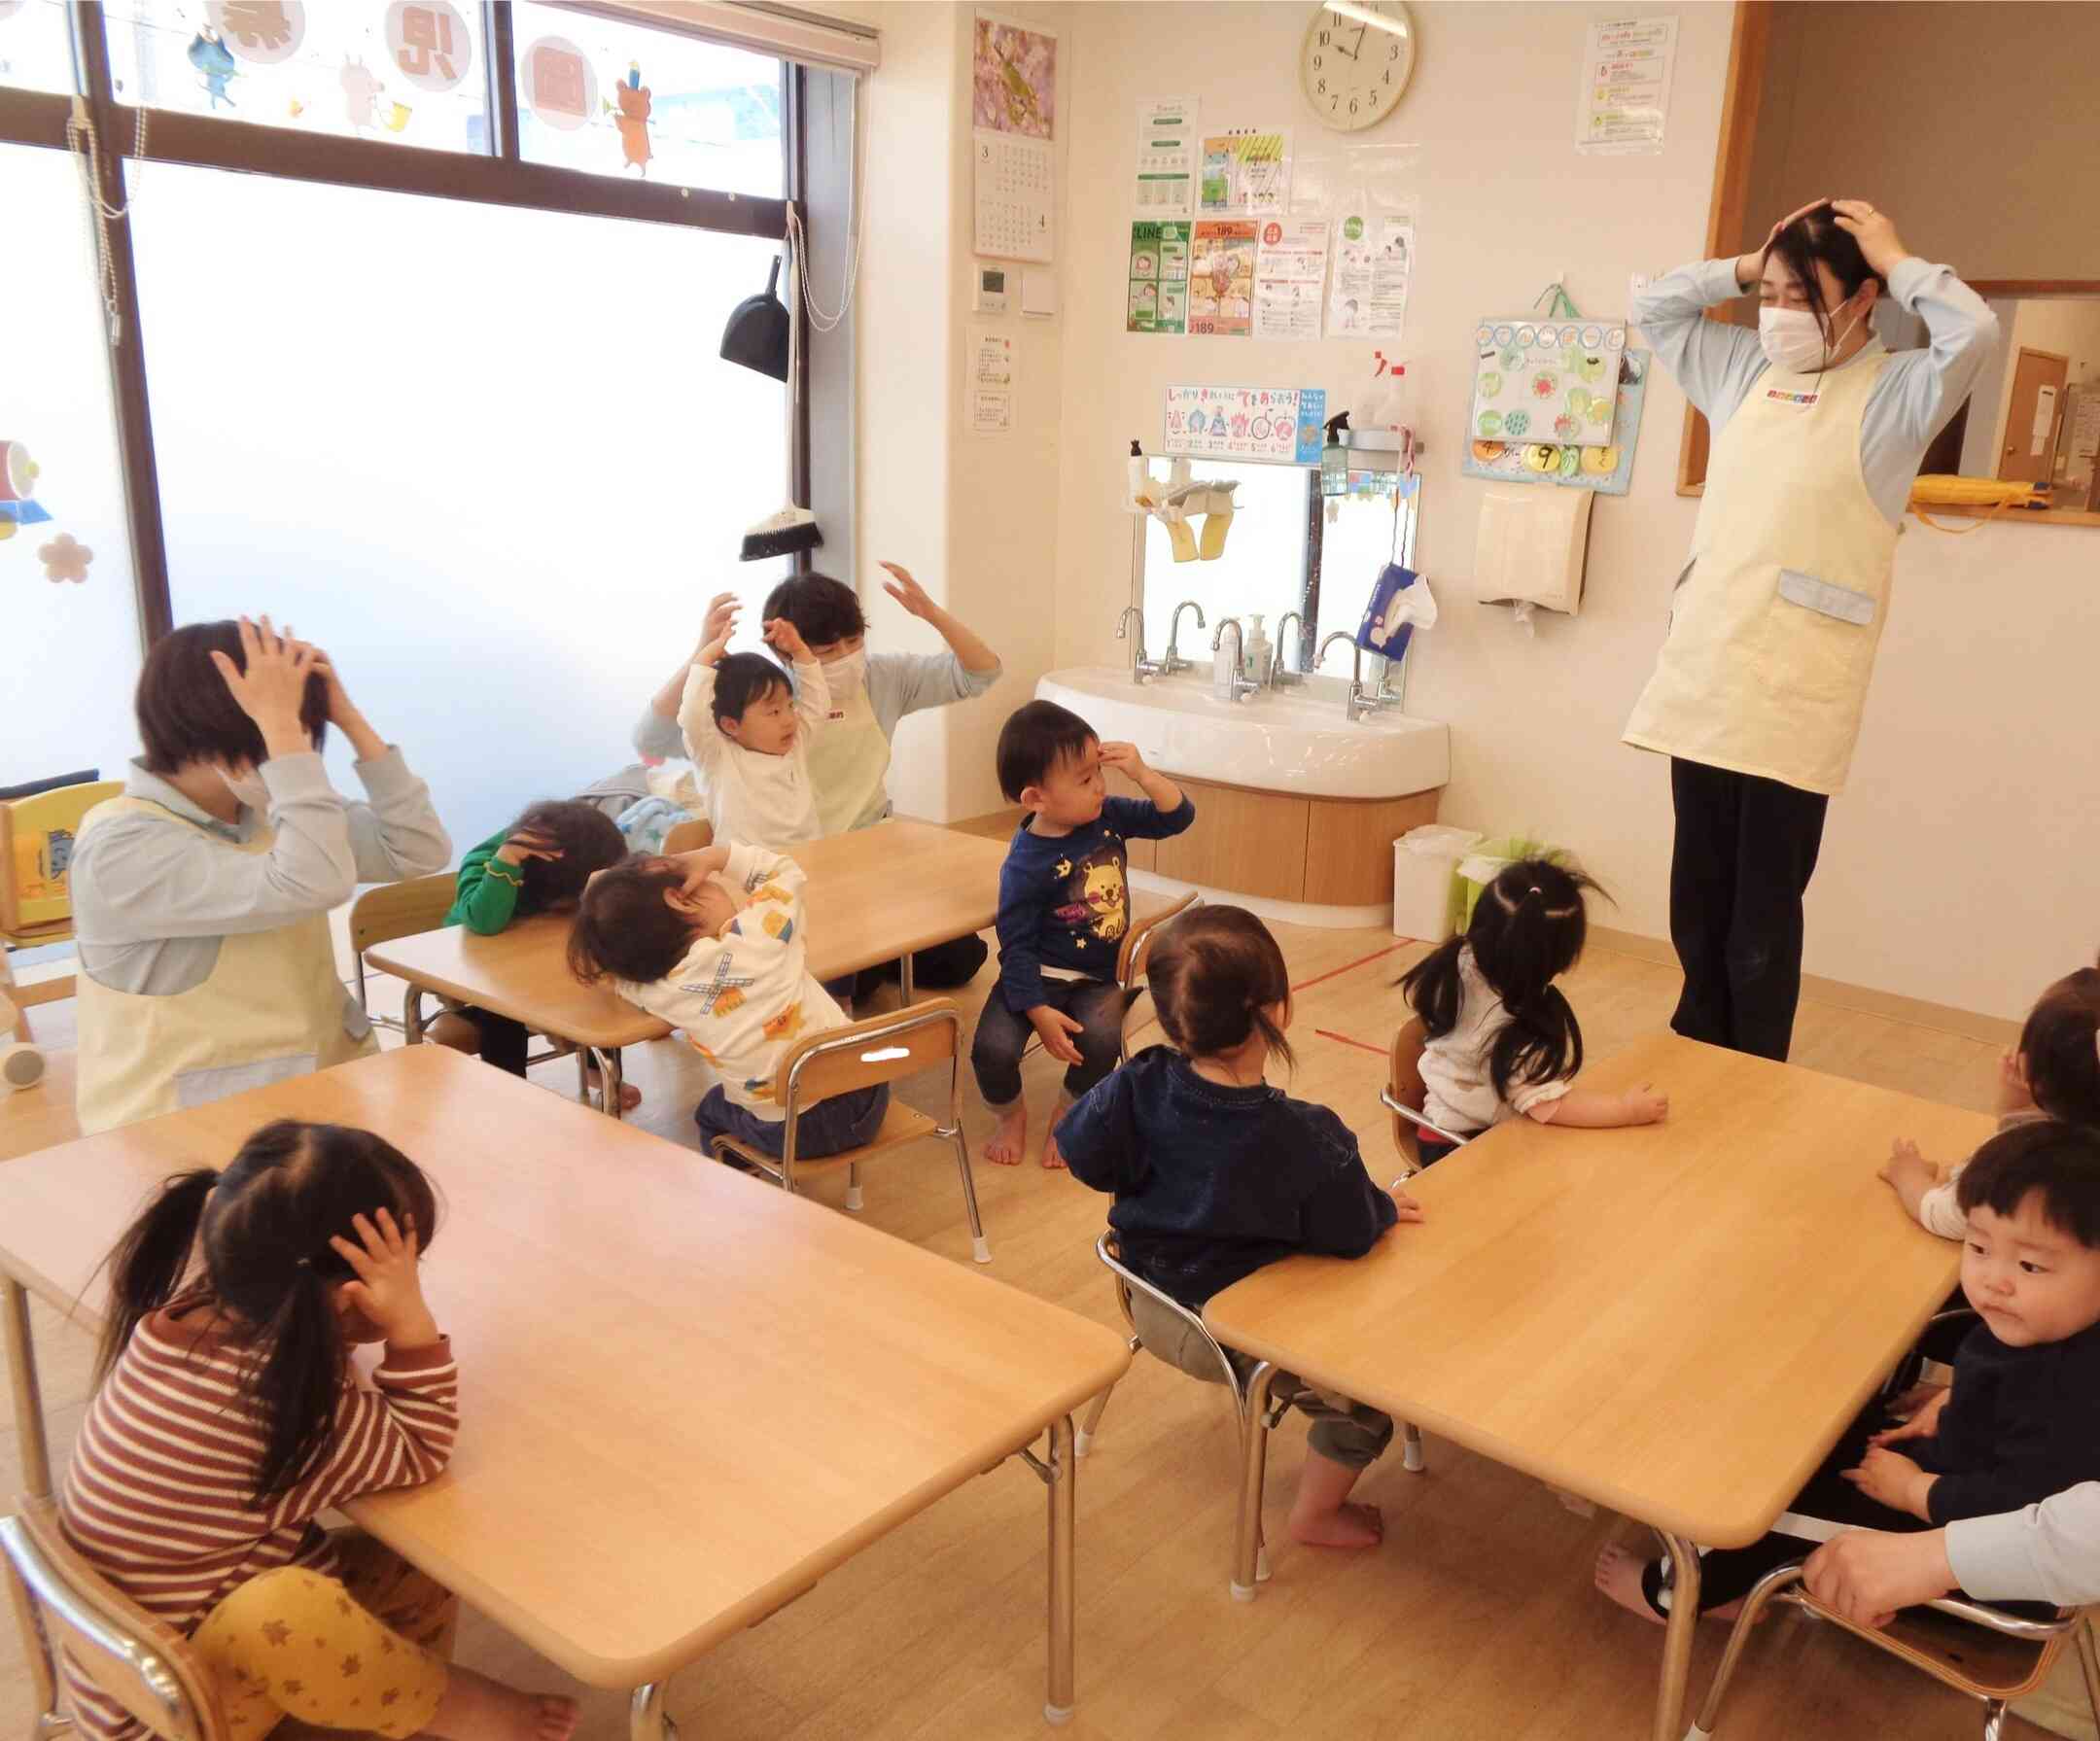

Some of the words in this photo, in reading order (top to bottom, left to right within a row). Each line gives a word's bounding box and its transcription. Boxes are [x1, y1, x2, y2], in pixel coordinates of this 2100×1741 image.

[1318, 30, 1330, 47] 10
[1389, 44, 1399, 60] 3
[1313, 54, 1322, 71] 9
[1382, 69, 1390, 85] 4
[1317, 78, 1326, 94] 8
[1331, 94, 1339, 110] 7
[1369, 89, 1378, 106] 5
[1348, 97, 1358, 115] 6
[981, 145, 989, 157] 3
[1137, 226, 1163, 239] LINE
[1197, 322, 1214, 334] 189
[1538, 443, 1554, 470] 9
